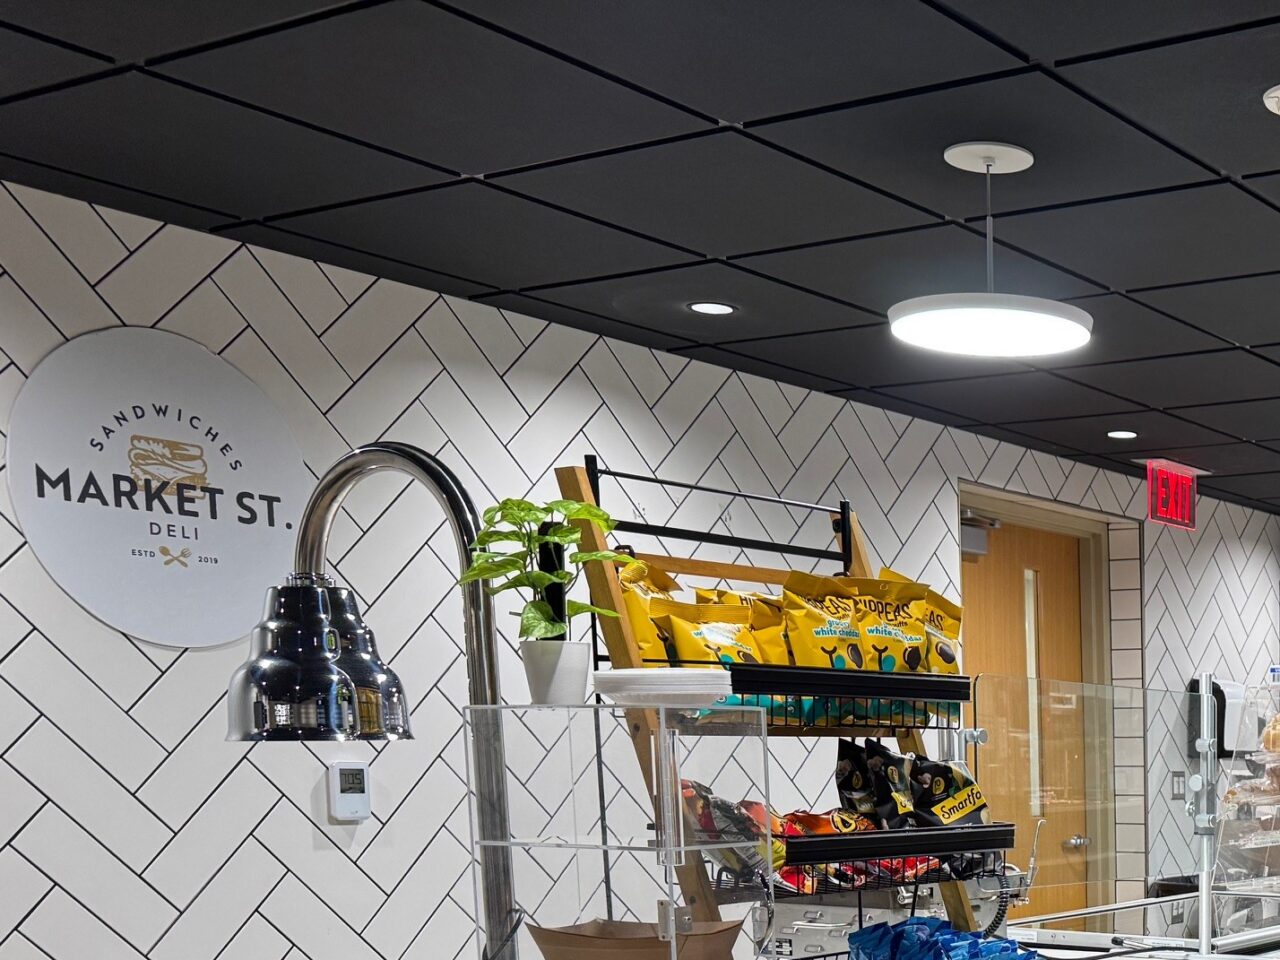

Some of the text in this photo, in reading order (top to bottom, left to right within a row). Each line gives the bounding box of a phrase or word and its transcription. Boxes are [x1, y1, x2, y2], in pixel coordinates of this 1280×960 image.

[90, 403, 242, 471] SANDWICHES
[35, 463, 293, 530] MARKET ST.
[1157, 468, 1192, 523] EXIT
[149, 522, 199, 540] DELI
[131, 549, 218, 564] ESTD 2019
[814, 627, 837, 637] white
[867, 627, 892, 636] white
[941, 788, 982, 819] Smartfo
